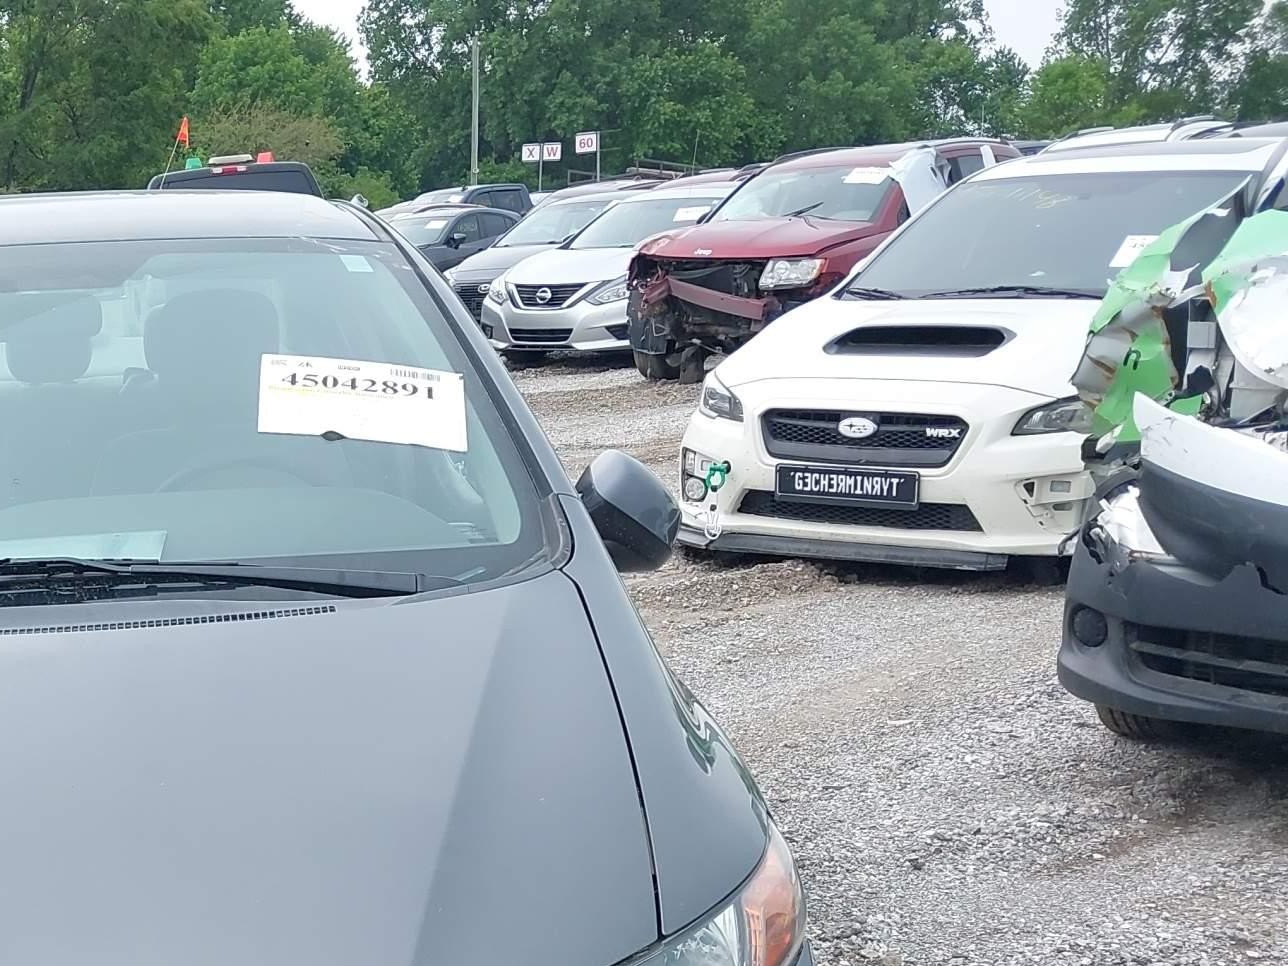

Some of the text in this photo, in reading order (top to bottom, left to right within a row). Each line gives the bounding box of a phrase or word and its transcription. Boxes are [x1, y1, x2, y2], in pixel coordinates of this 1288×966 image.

[579, 138, 594, 149] 60
[527, 147, 536, 159] X
[546, 146, 559, 158] W
[281, 372, 435, 401] 45042891
[925, 427, 961, 439] WRX
